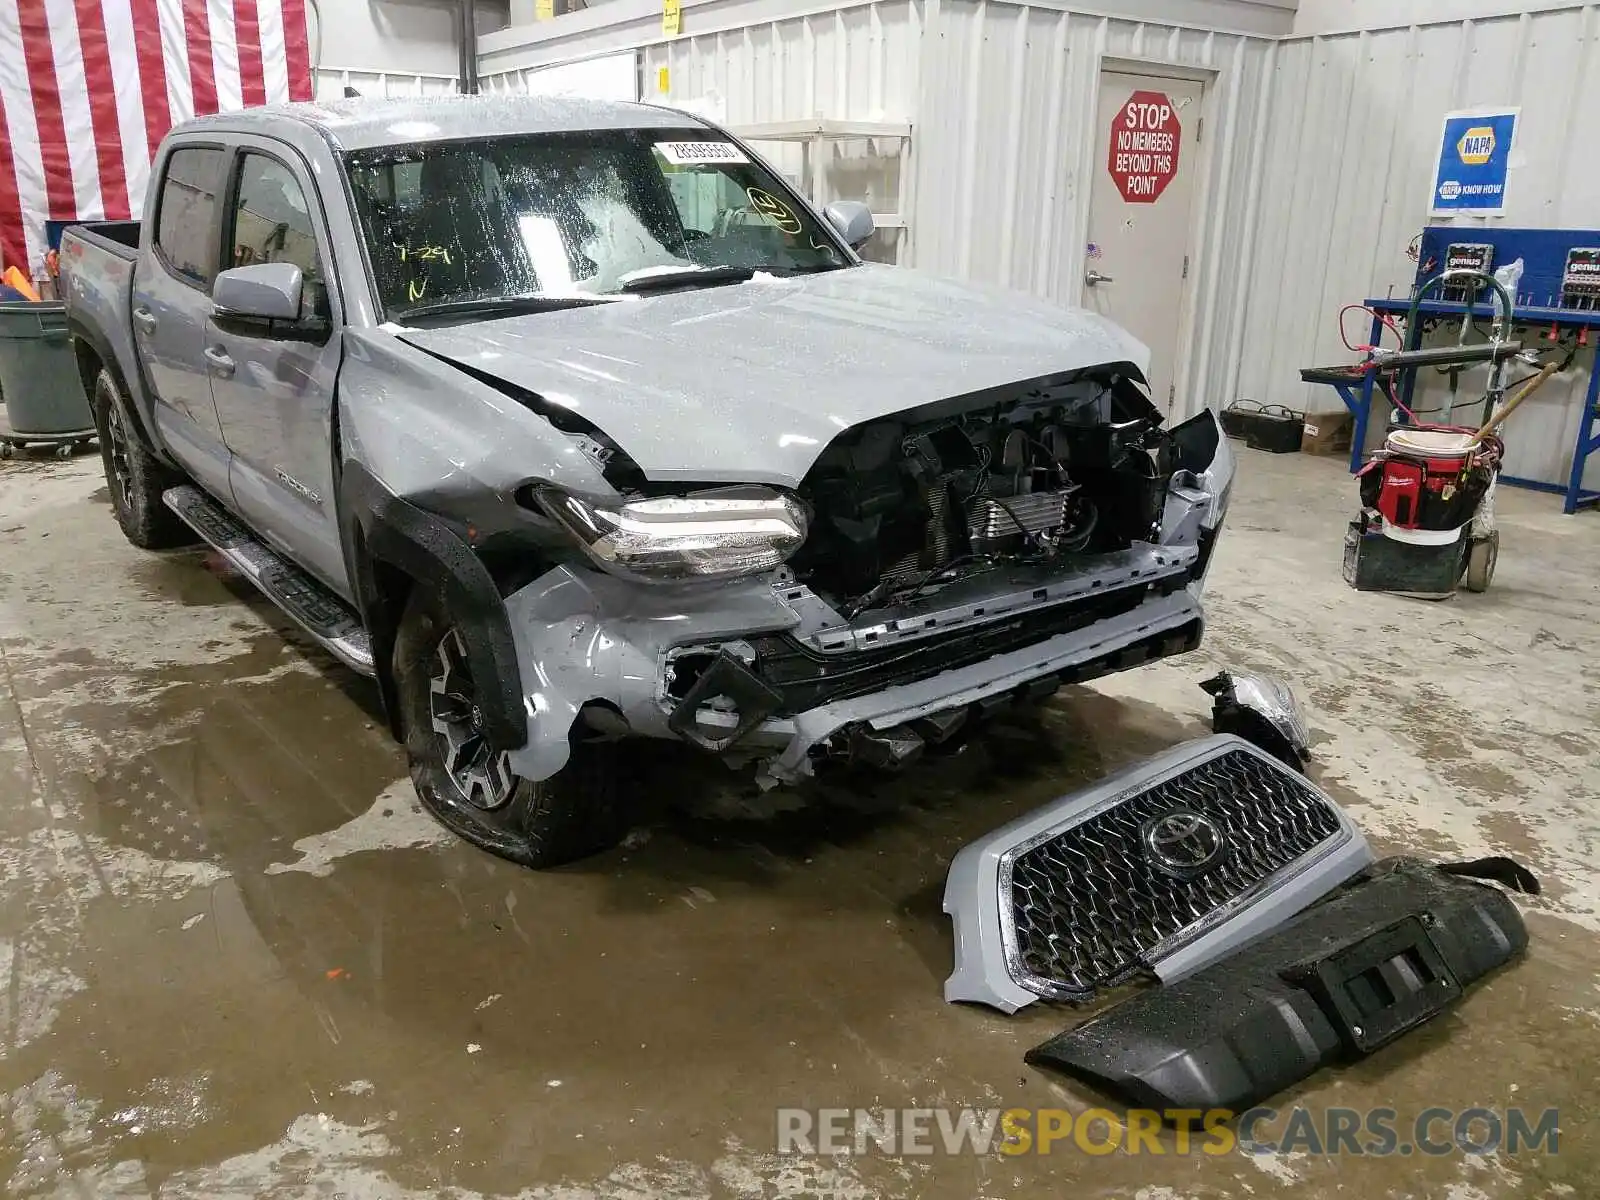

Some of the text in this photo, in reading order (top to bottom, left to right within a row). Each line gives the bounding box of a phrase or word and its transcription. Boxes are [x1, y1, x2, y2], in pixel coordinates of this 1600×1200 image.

[1125, 102, 1170, 129] STOP
[1117, 130, 1173, 152] NO MEMBERS
[1464, 136, 1491, 154] NAPA
[1116, 153, 1171, 174] BEYOND THIS
[1127, 175, 1158, 195] POINT
[1462, 185, 1482, 195] KNOW
[1482, 184, 1502, 194] HOW
[1449, 257, 1481, 266] genius
